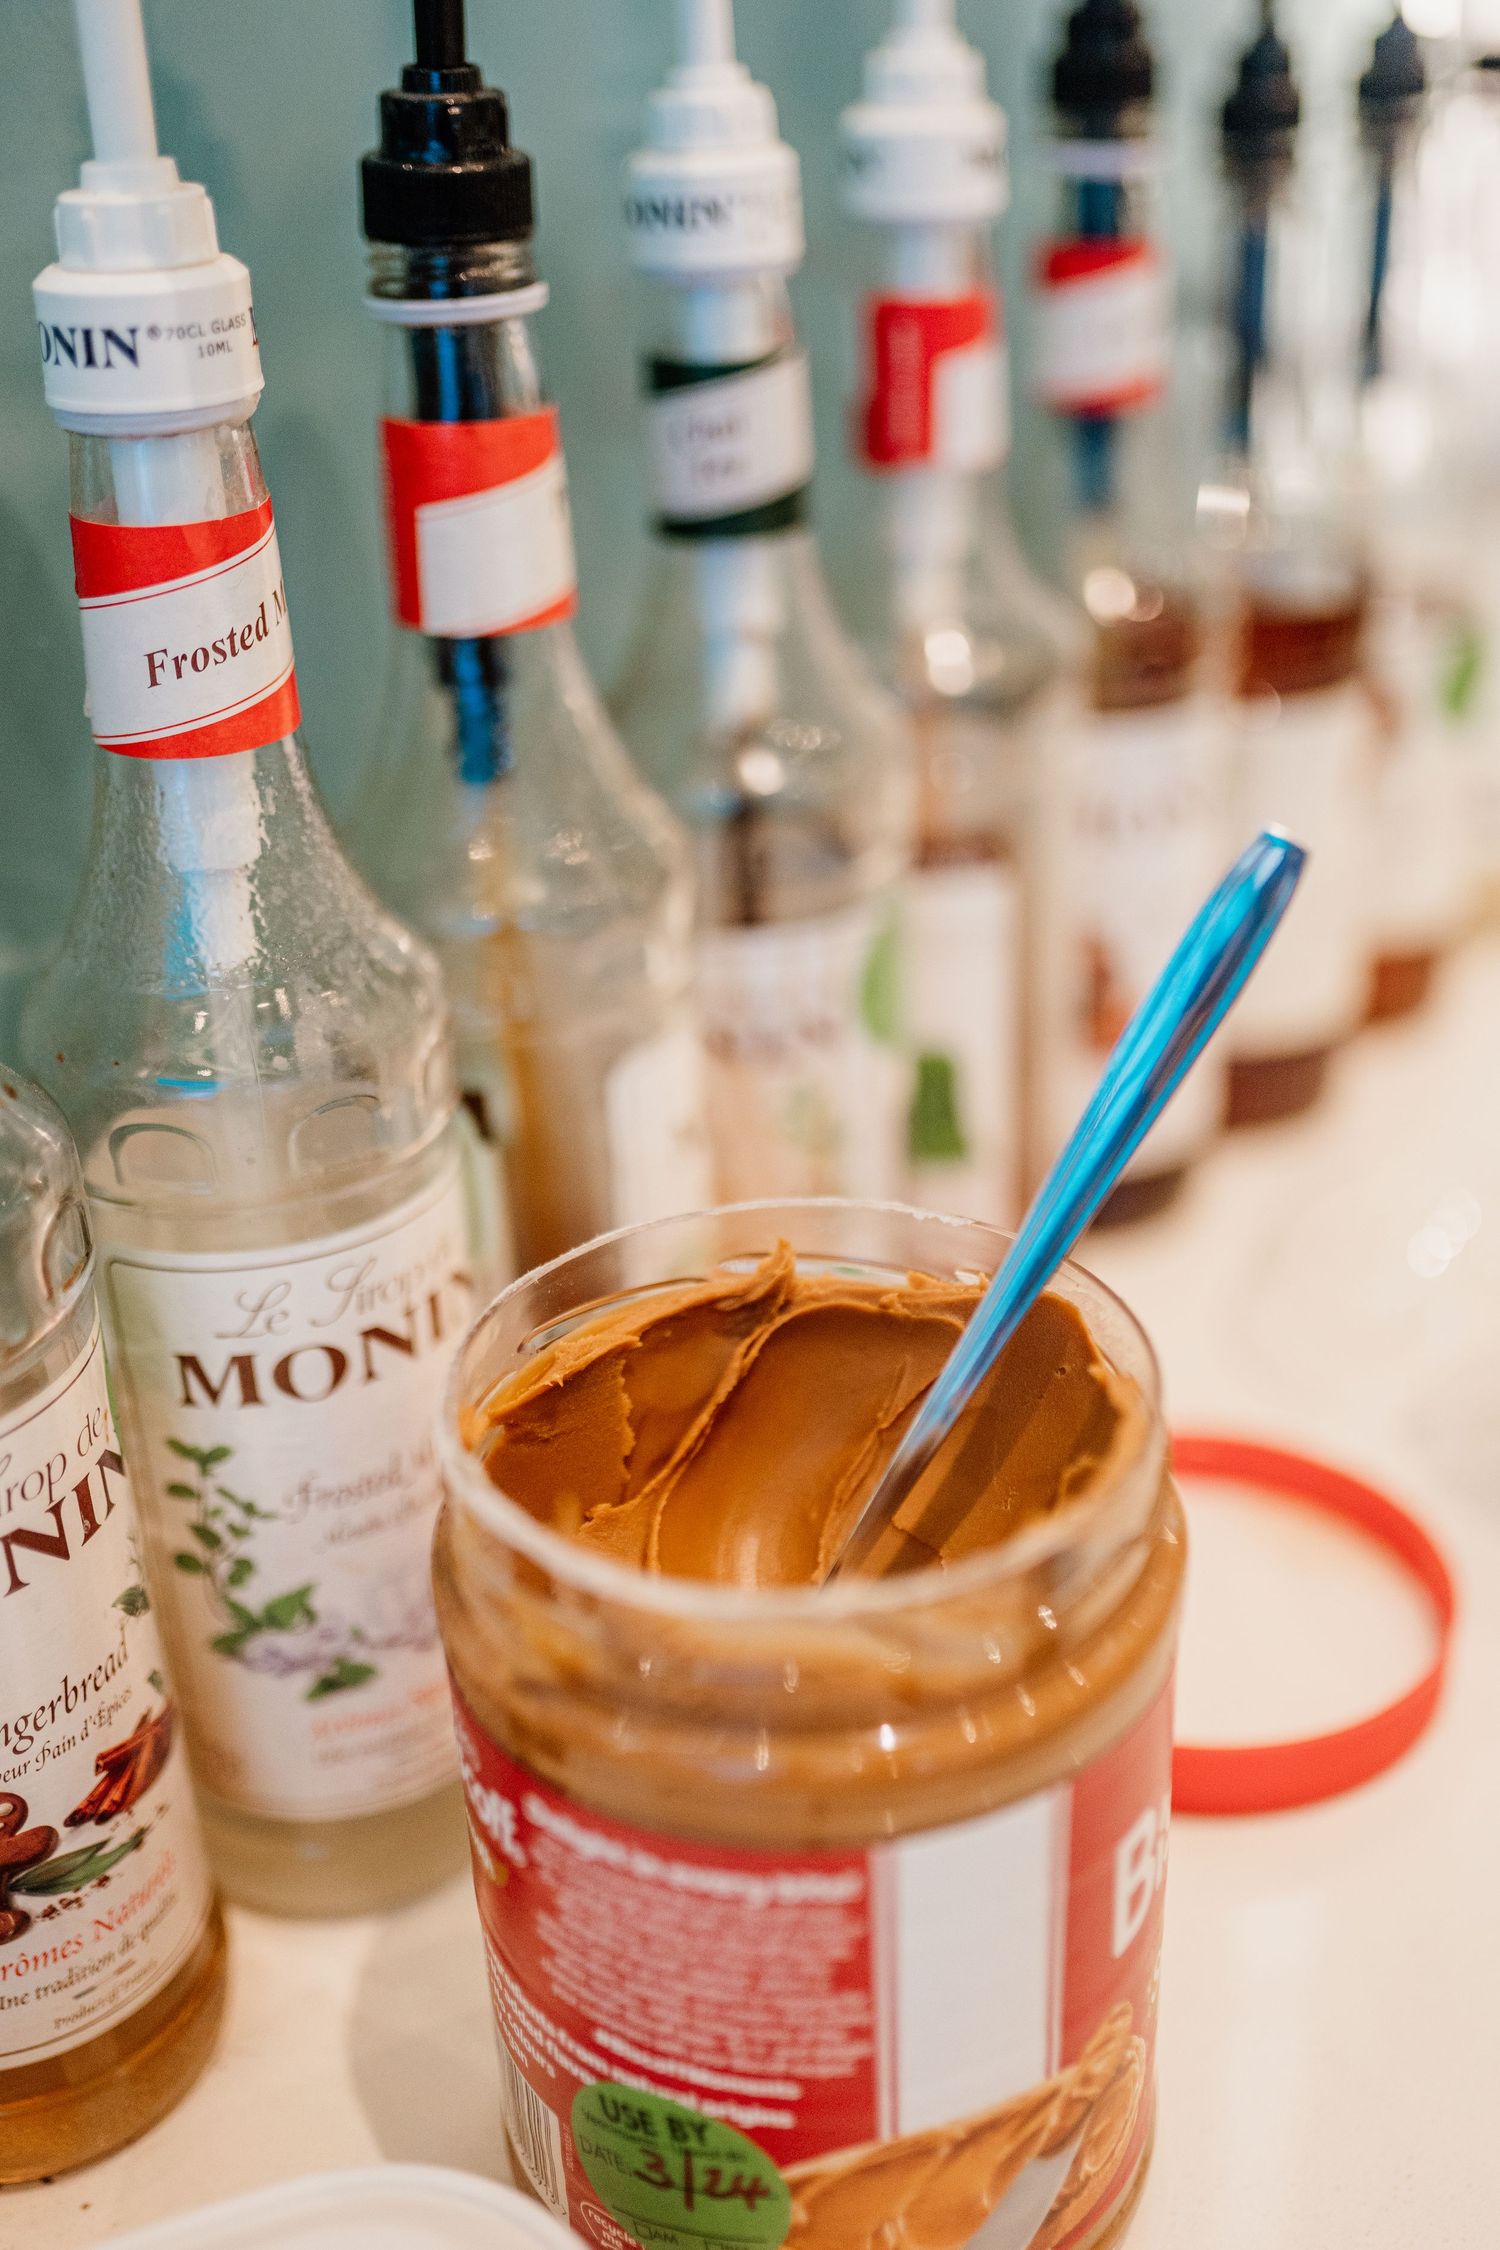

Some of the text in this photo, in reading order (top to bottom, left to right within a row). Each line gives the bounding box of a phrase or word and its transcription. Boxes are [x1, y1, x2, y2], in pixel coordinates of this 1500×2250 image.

[38, 320, 139, 369] ONIN
[210, 312, 248, 335] GLASS
[144, 601, 269, 689] Frosted
[77, 1407, 102, 1458] de
[0, 1617, 129, 1756] ngerbread
[0, 1931, 84, 1982] rômes
[598, 2091, 659, 2139] USE
[664, 2114, 709, 2147] BY
[588, 2208, 638, 2248] recycle
